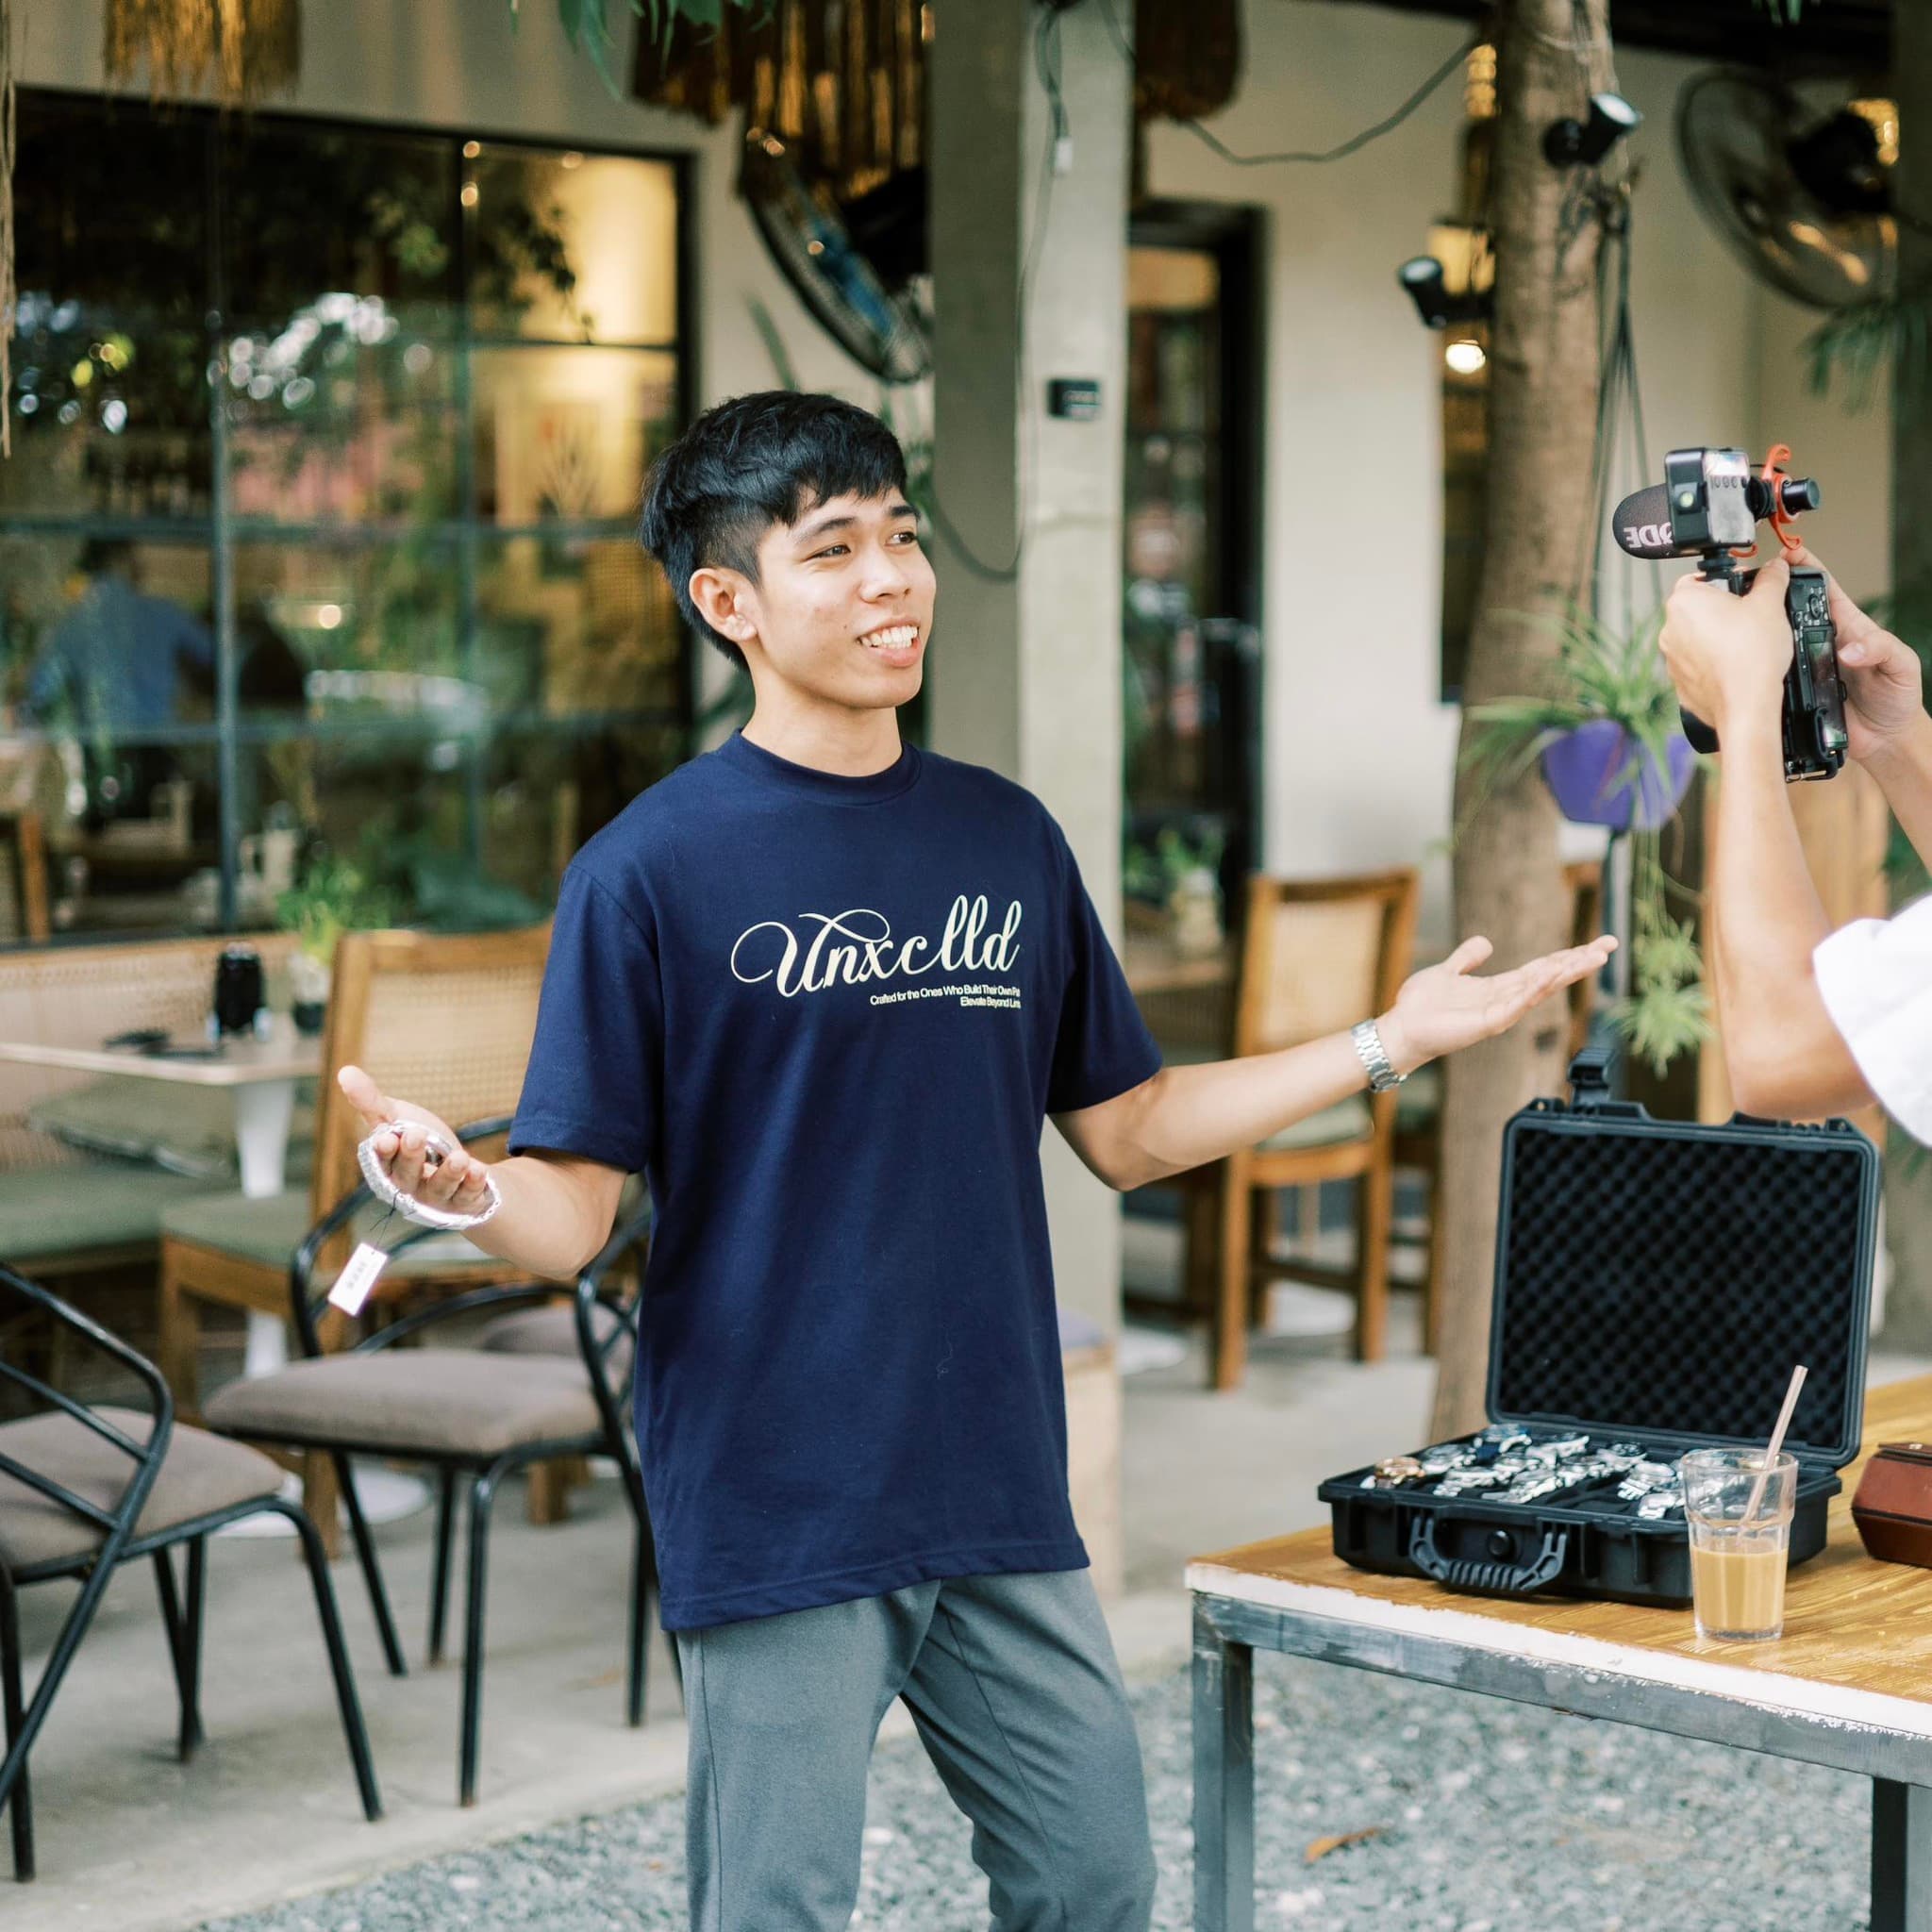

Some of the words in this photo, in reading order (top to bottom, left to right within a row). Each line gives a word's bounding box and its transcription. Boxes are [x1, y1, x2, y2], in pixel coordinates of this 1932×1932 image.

[897, 991, 907, 1002] for
[907, 990, 920, 1000] the
[920, 988, 943, 997] Ones
[943, 985, 963, 995] Who
[963, 984, 982, 994] Build
[986, 996, 1009, 1008] Beyond
